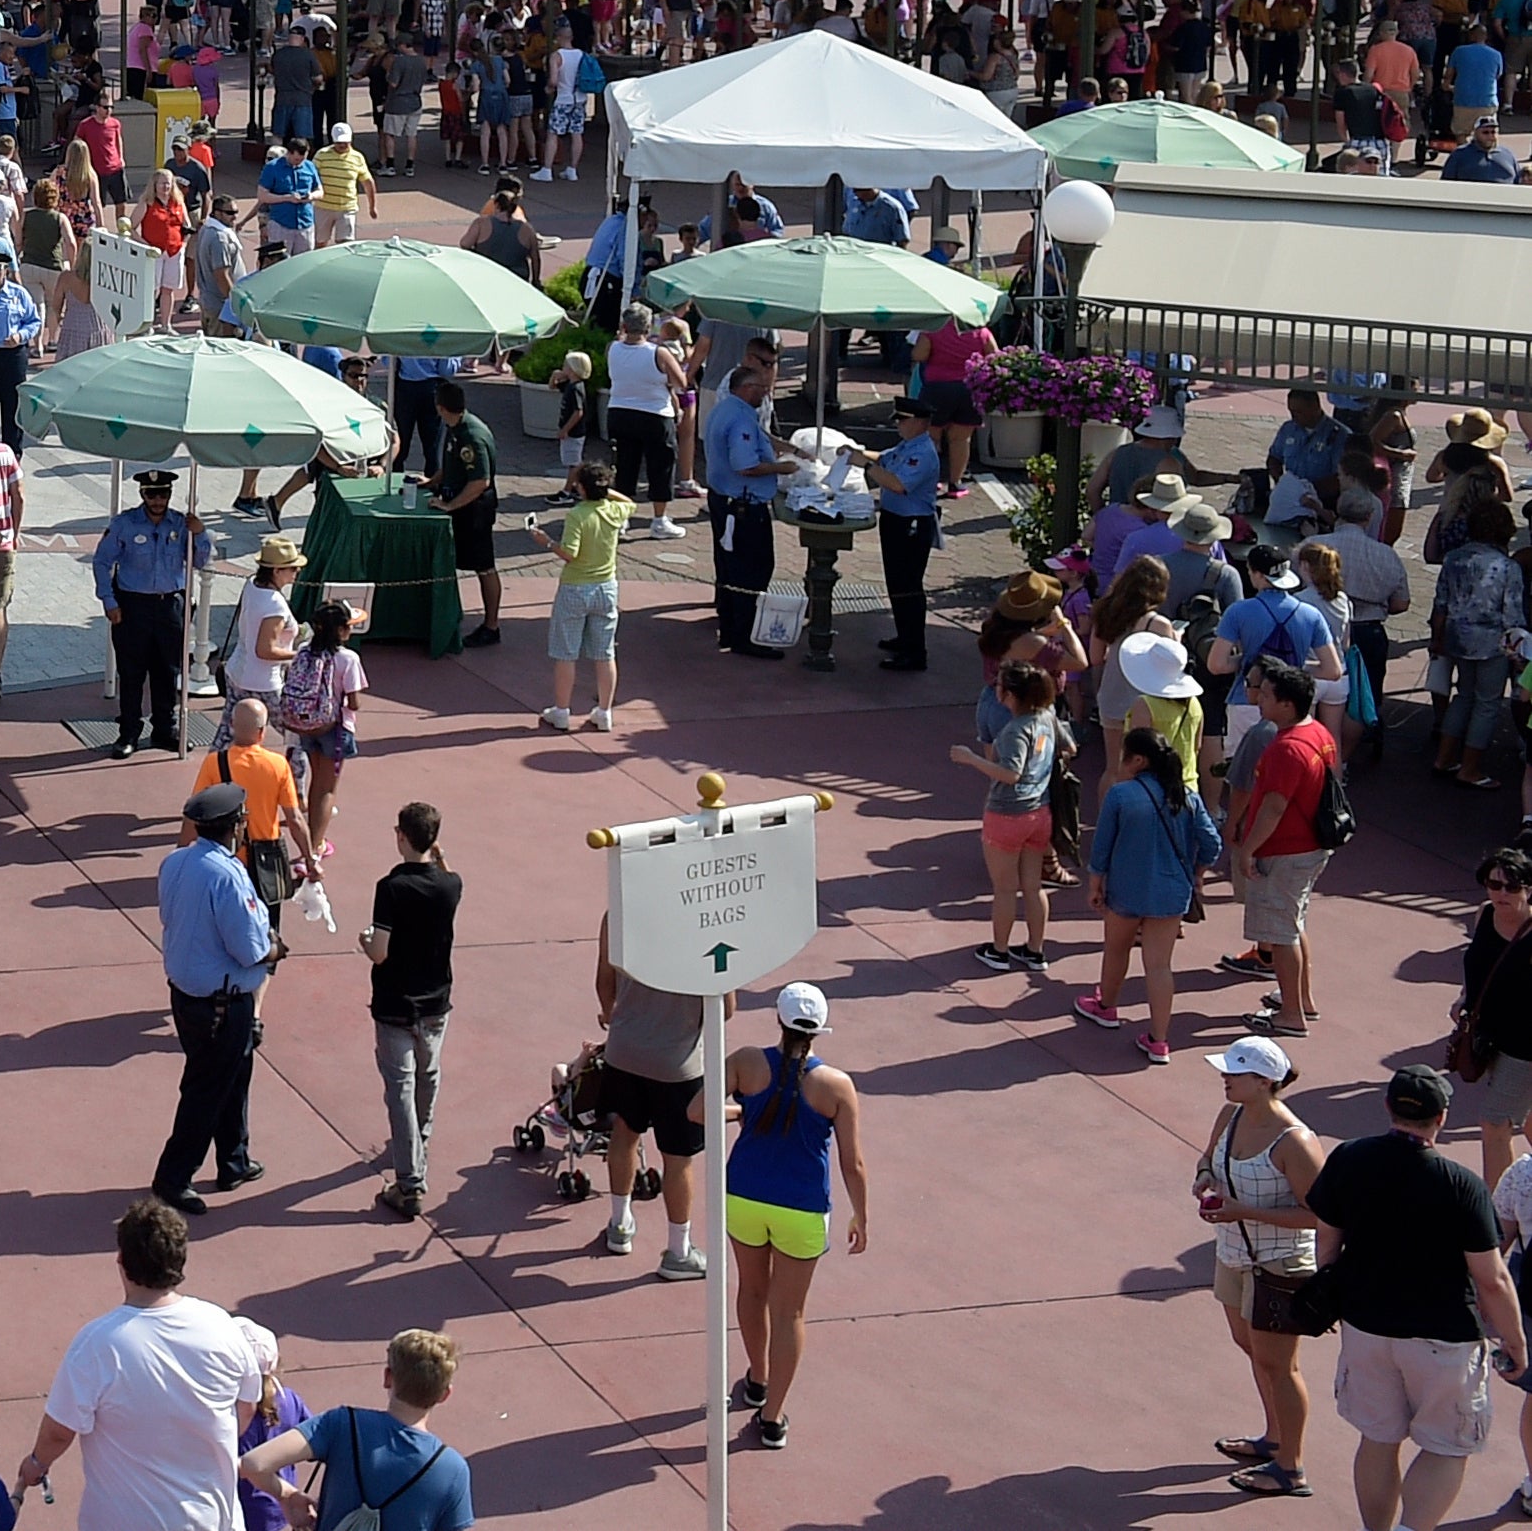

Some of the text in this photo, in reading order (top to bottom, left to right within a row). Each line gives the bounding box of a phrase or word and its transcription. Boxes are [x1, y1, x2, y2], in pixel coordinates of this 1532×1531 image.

[97, 261, 138, 299] EXIT
[686, 853, 757, 881] GUESTS
[679, 873, 766, 906] WITHOUT
[699, 905, 746, 929] BAGS
